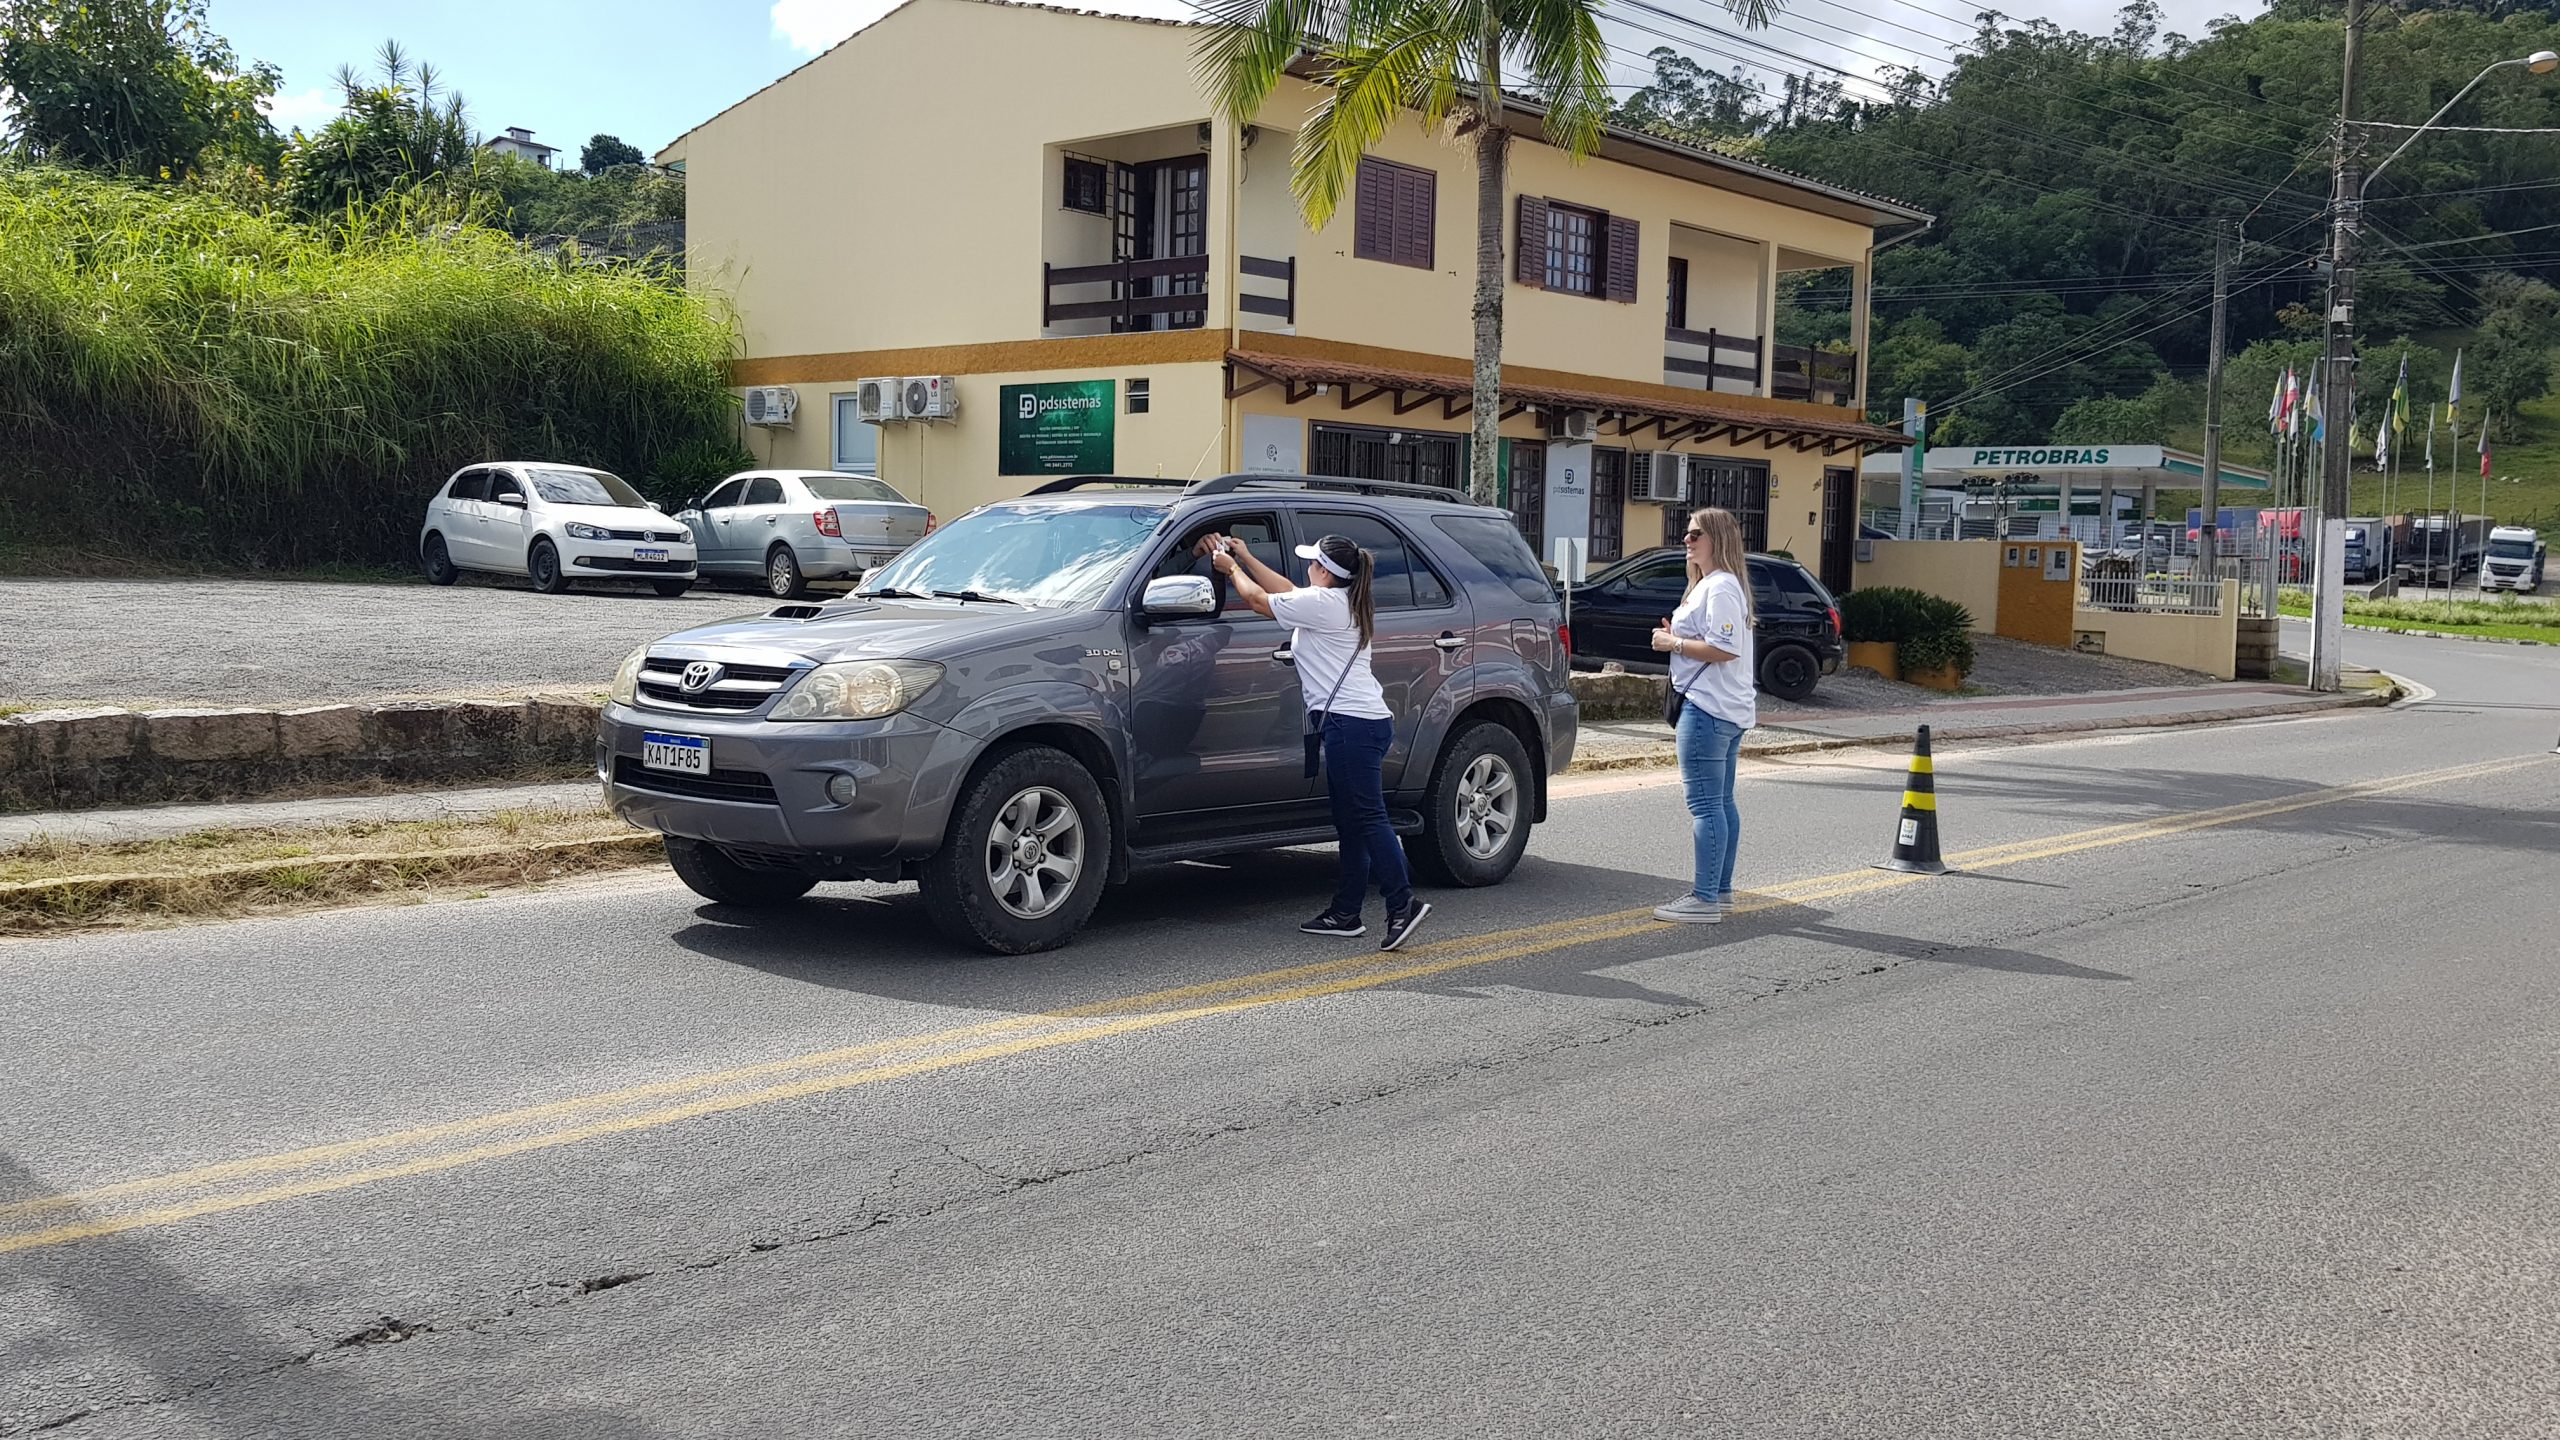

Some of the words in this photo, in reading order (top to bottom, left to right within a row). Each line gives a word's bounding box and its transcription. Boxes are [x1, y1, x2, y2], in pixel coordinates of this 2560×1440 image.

[1039, 395, 1102, 414] pdsistemas
[1973, 449, 2110, 465] PETROBRAS
[648, 744, 701, 769] KAT1F85
